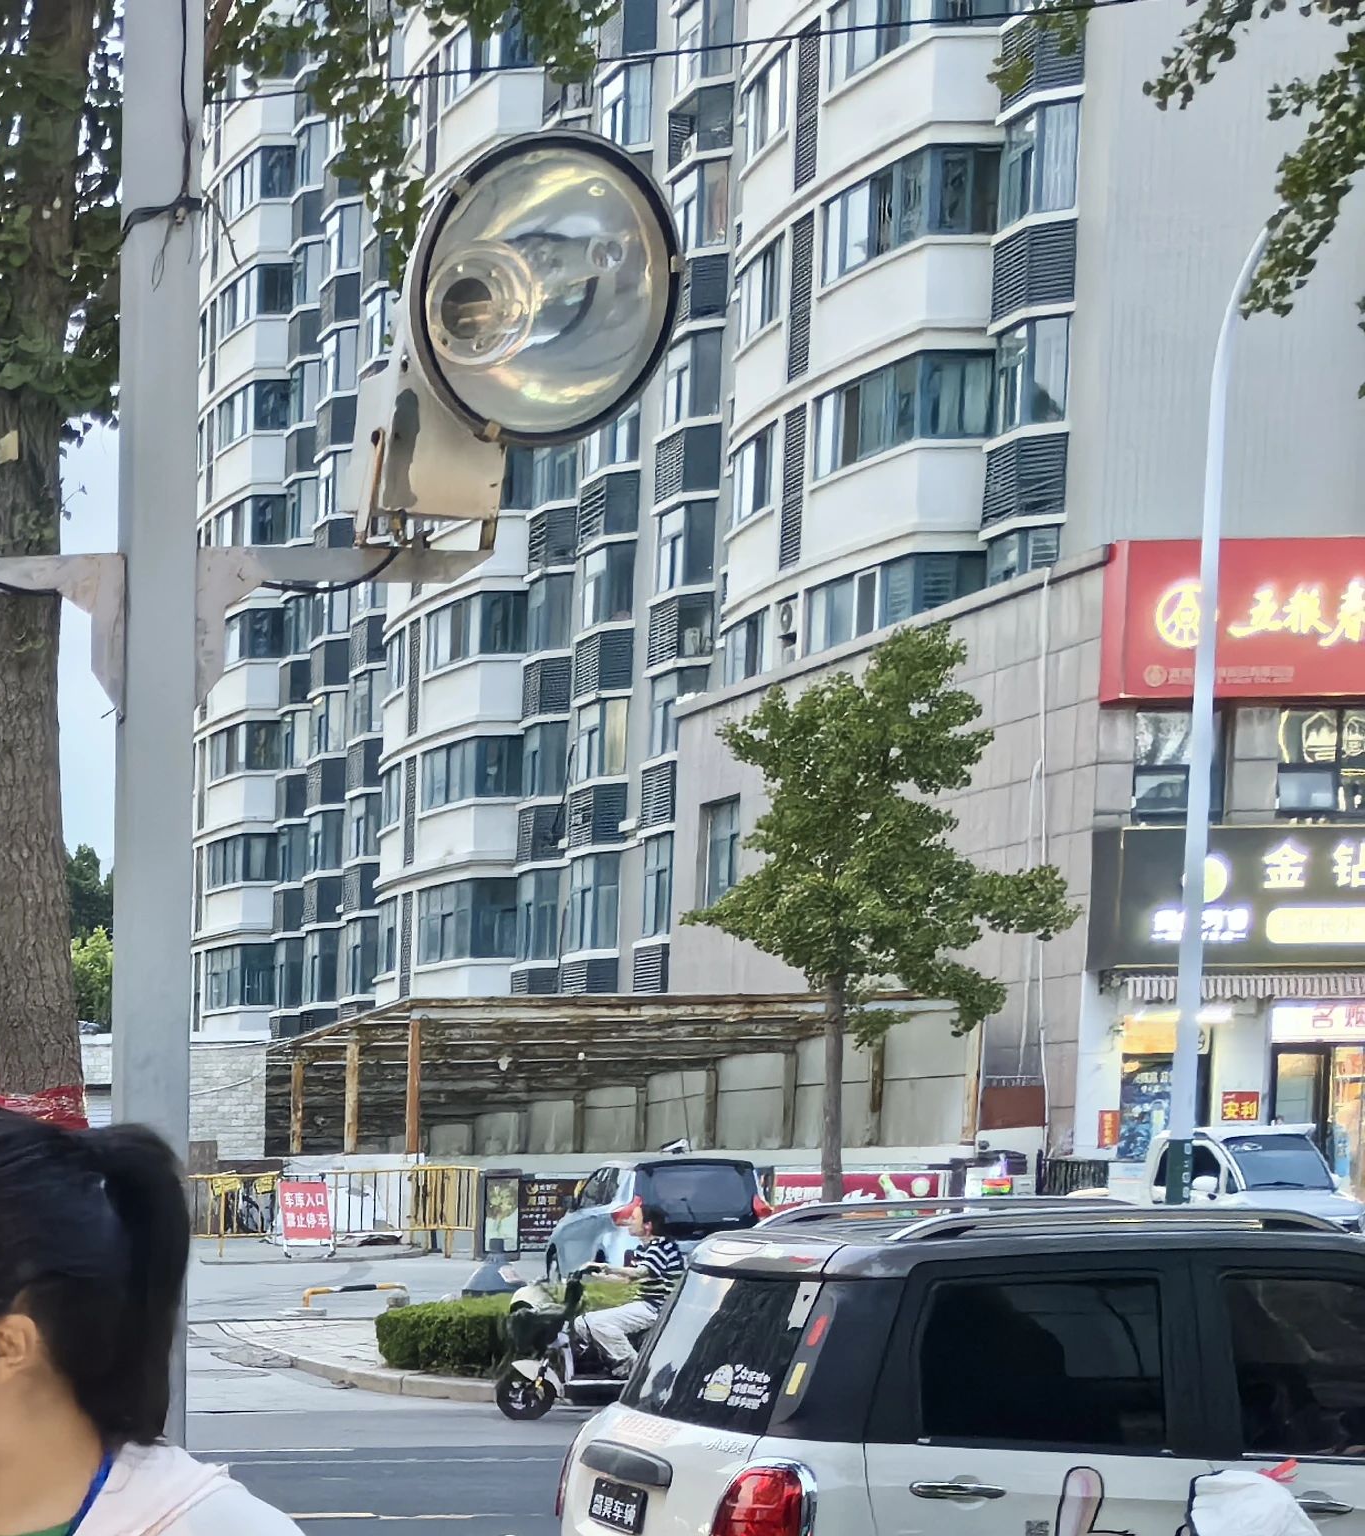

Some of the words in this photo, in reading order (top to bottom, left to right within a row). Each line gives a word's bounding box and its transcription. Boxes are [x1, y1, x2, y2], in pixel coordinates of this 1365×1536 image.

[283, 1192, 325, 1208] 车库入口
[285, 1212, 328, 1229] 禁止停车
